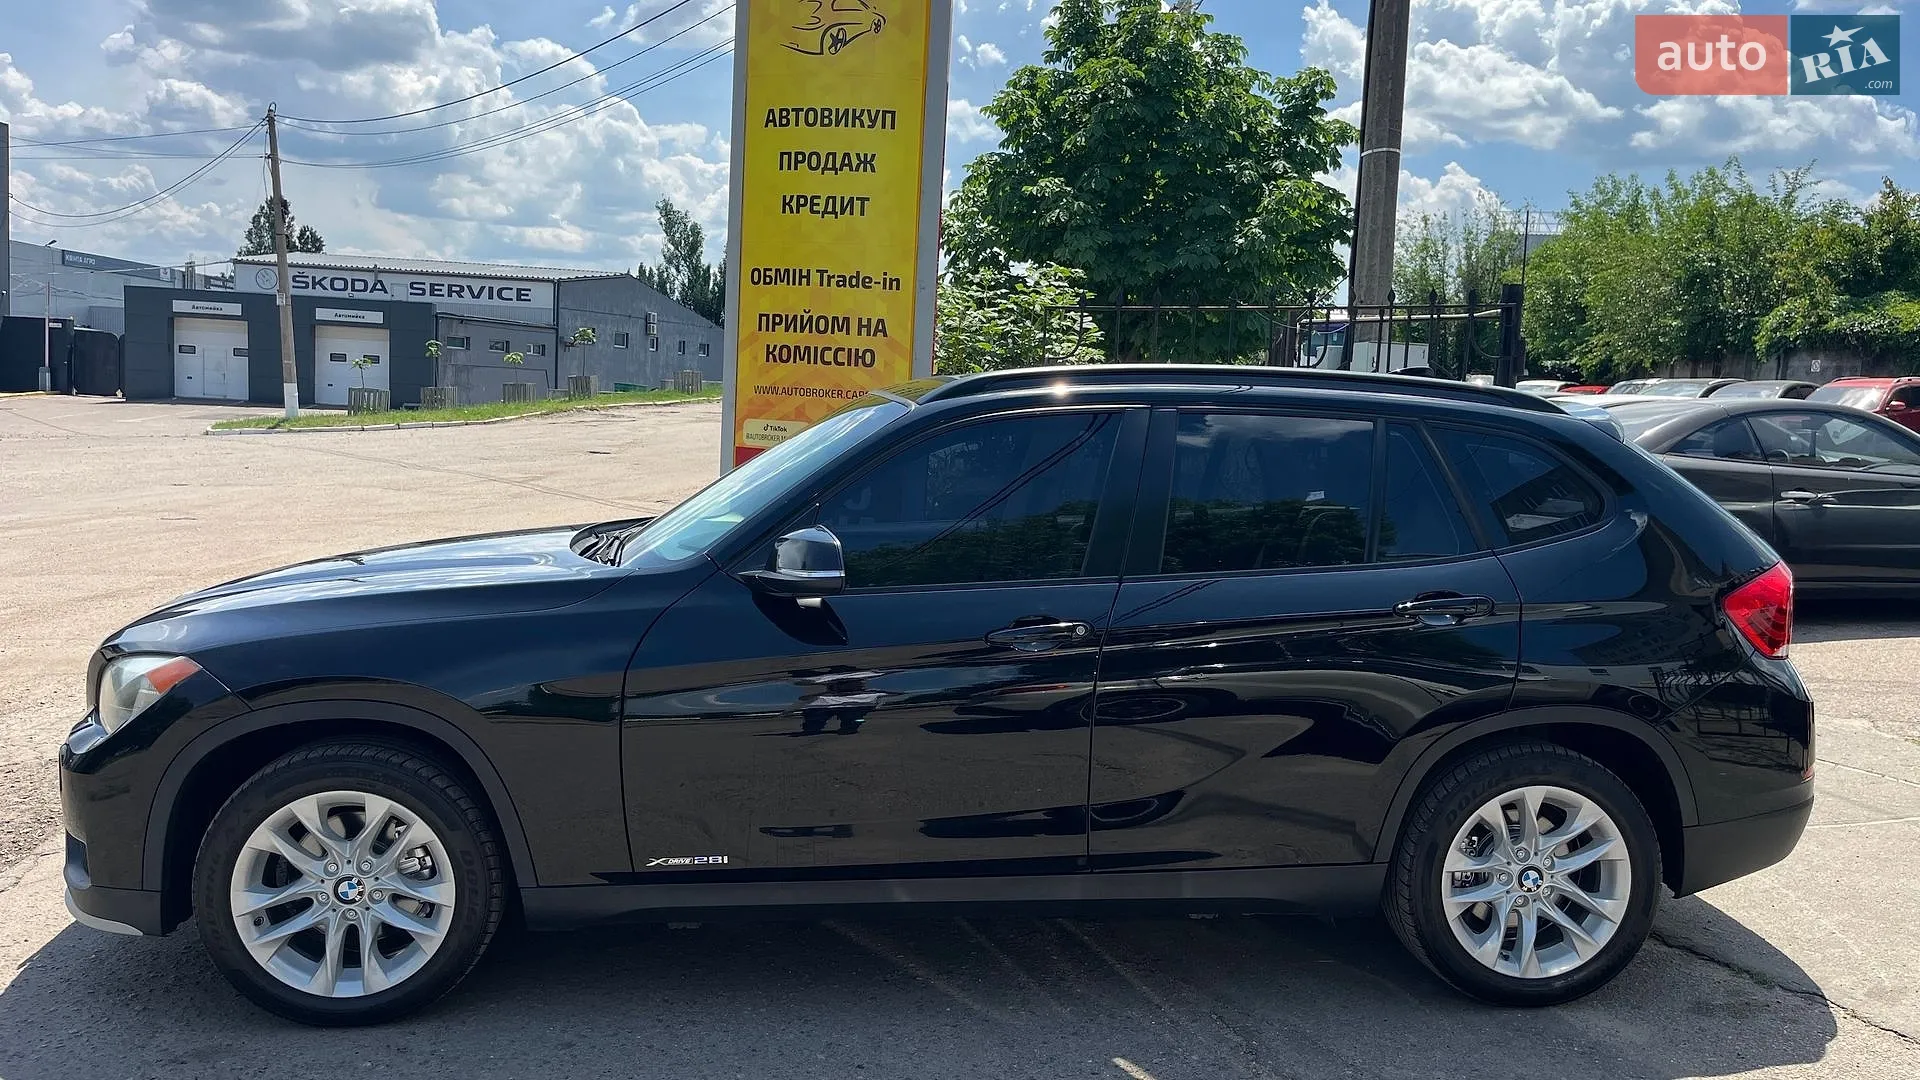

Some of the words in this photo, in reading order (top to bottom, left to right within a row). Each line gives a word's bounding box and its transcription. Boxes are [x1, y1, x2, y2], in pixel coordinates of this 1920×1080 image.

[764, 107, 897, 130] АВТОВИКУП
[779, 151, 877, 175] ПРОДАЖ
[781, 194, 871, 219] КРЕДИТ
[292, 271, 389, 295] ŠKODA
[409, 281, 532, 303] SERVICE
[750, 267, 811, 287] ОБМІН
[816, 269, 901, 291] Trade-in
[757, 309, 850, 336] ПРИЙОМ
[857, 317, 888, 338] НА
[765, 343, 876, 368] КОМІССІЮ
[769, 425, 788, 433] TikTok
